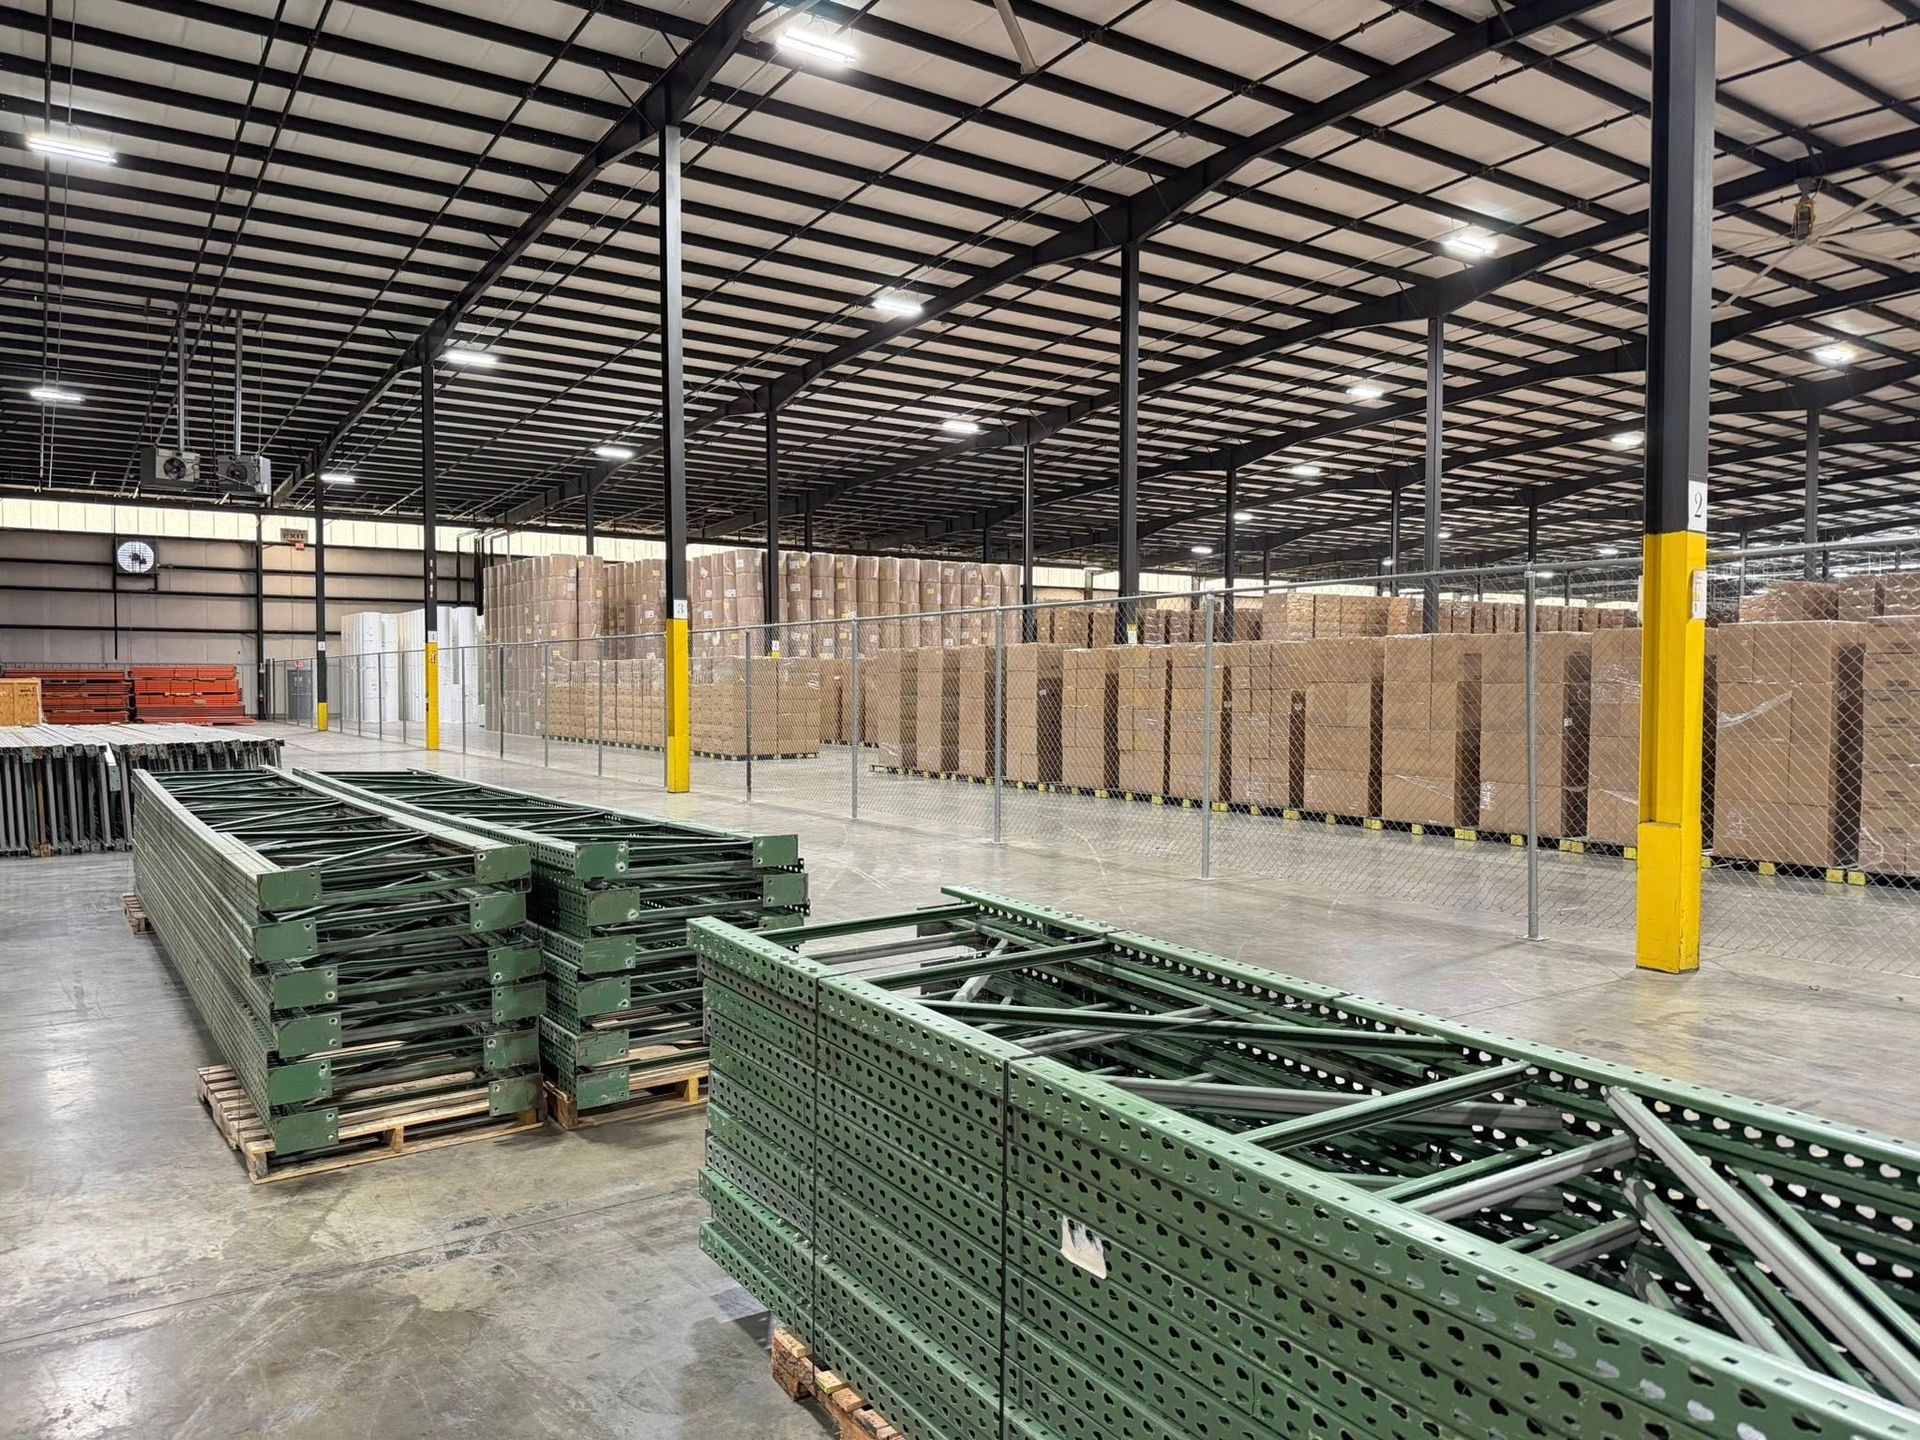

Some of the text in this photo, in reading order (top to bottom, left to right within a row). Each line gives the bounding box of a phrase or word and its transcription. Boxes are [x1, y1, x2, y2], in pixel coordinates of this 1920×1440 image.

[1694, 491, 1703, 518] 2
[283, 532, 304, 540] EXIT
[677, 603, 684, 614] 3
